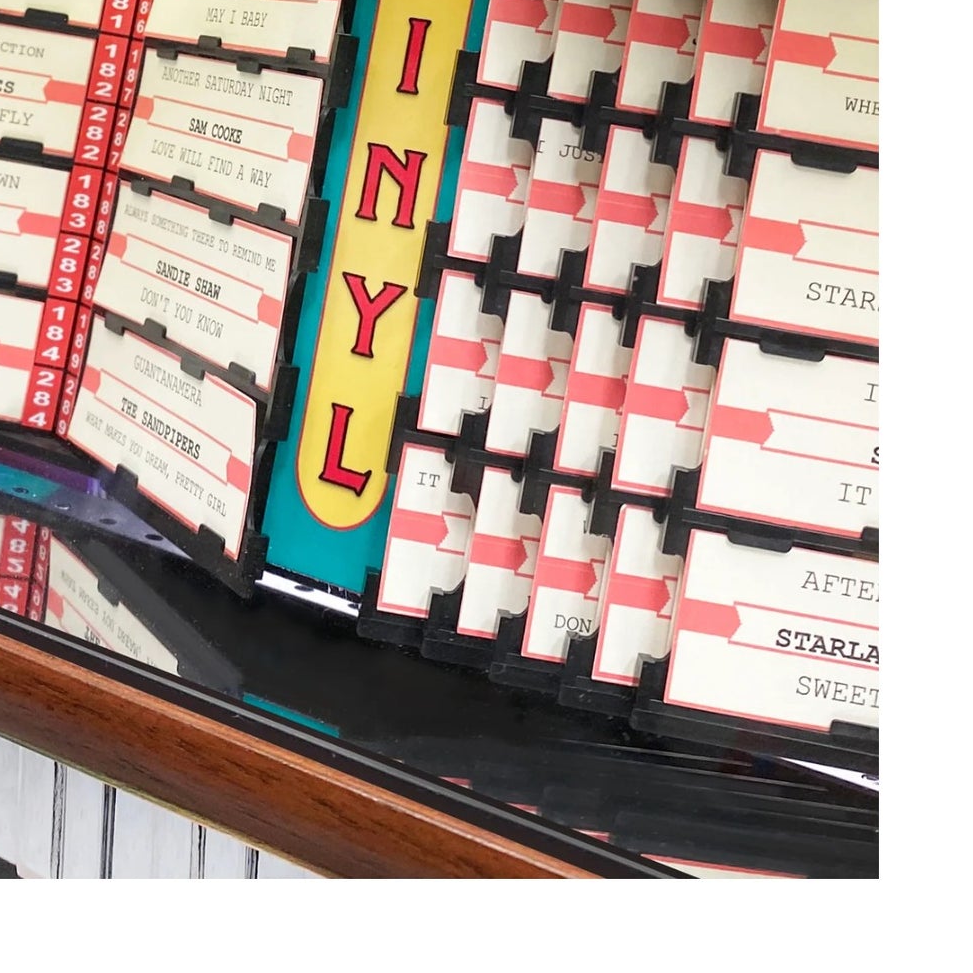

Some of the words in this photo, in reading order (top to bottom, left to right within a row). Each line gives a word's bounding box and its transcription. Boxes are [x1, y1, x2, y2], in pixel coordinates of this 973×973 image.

[206, 7, 224, 23] MAY
[229, 10, 236, 24] I
[240, 11, 268, 27] BABY
[161, 66, 201, 89] ANOTHER
[205, 74, 254, 99] SATURDAY
[259, 85, 293, 107] NIGHT
[189, 118, 207, 135] SAM
[211, 123, 243, 145] COOKE
[151, 139, 174, 159] LOVE
[179, 147, 203, 168] WILL
[208, 155, 233, 177] FIND
[236, 165, 245, 179] A
[249, 168, 273, 189] WAY
[150, 211, 189, 238] SOMETHING
[192, 224, 215, 245] THERE
[219, 236, 229, 252] TO
[232, 242, 263, 265] REMIND
[266, 255, 277, 272] ME
[155, 260, 191, 288] SANDIE
[195, 277, 221, 300] SHAW
[807, 282, 879, 311] STAR
[140, 287, 170, 313] DON'T
[174, 306, 192, 328] YOU
[196, 314, 224, 339] KNOW
[133, 355, 202, 407] GUANTANAMERA
[121, 397, 138, 420] THE
[142, 411, 201, 460] SANDPIPERS
[104, 421, 126, 446] MAKES
[129, 441, 143, 457] YOU
[145, 448, 170, 480] DREAM,
[174, 471, 204, 500] PRETTY
[207, 491, 227, 517] GIRL
[417, 471, 440, 489] IT
[838, 482, 872, 506] IT
[801, 570, 879, 602] AFTE
